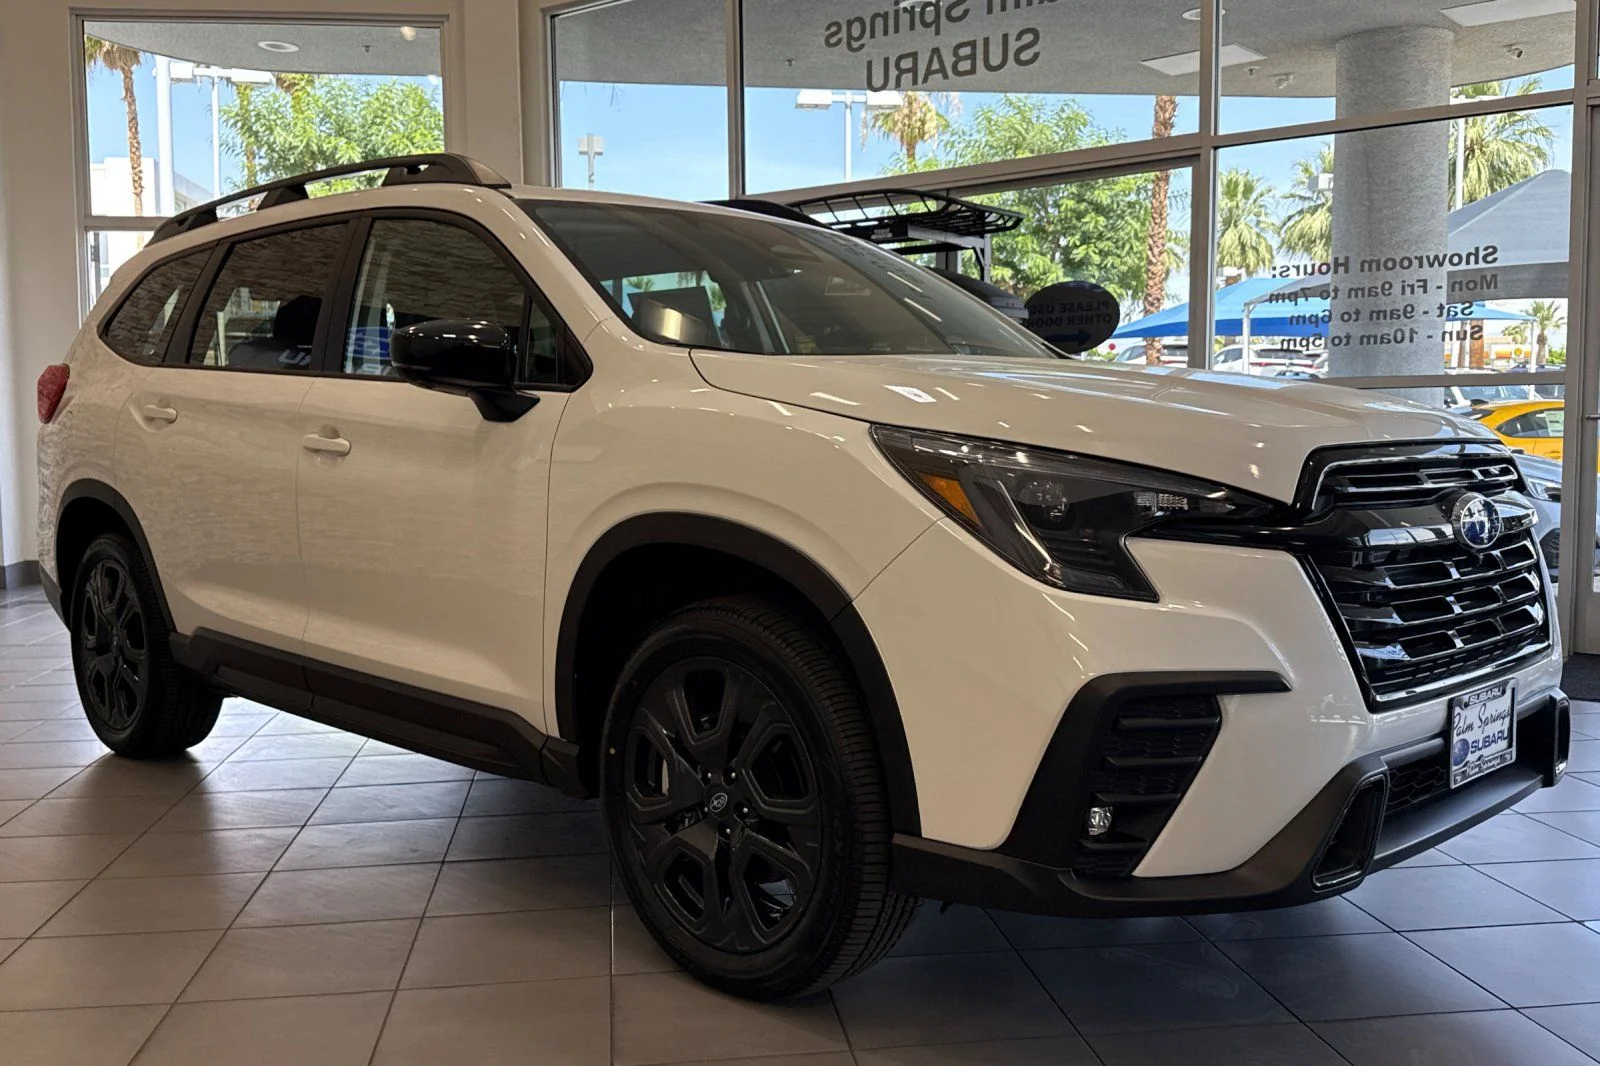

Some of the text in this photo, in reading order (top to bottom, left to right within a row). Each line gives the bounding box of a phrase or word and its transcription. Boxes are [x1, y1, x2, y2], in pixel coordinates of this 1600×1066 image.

[1469, 686, 1503, 705] SUBARU
[1453, 703, 1511, 736] Palm Springs
[1470, 730, 1508, 754] SUBARU
